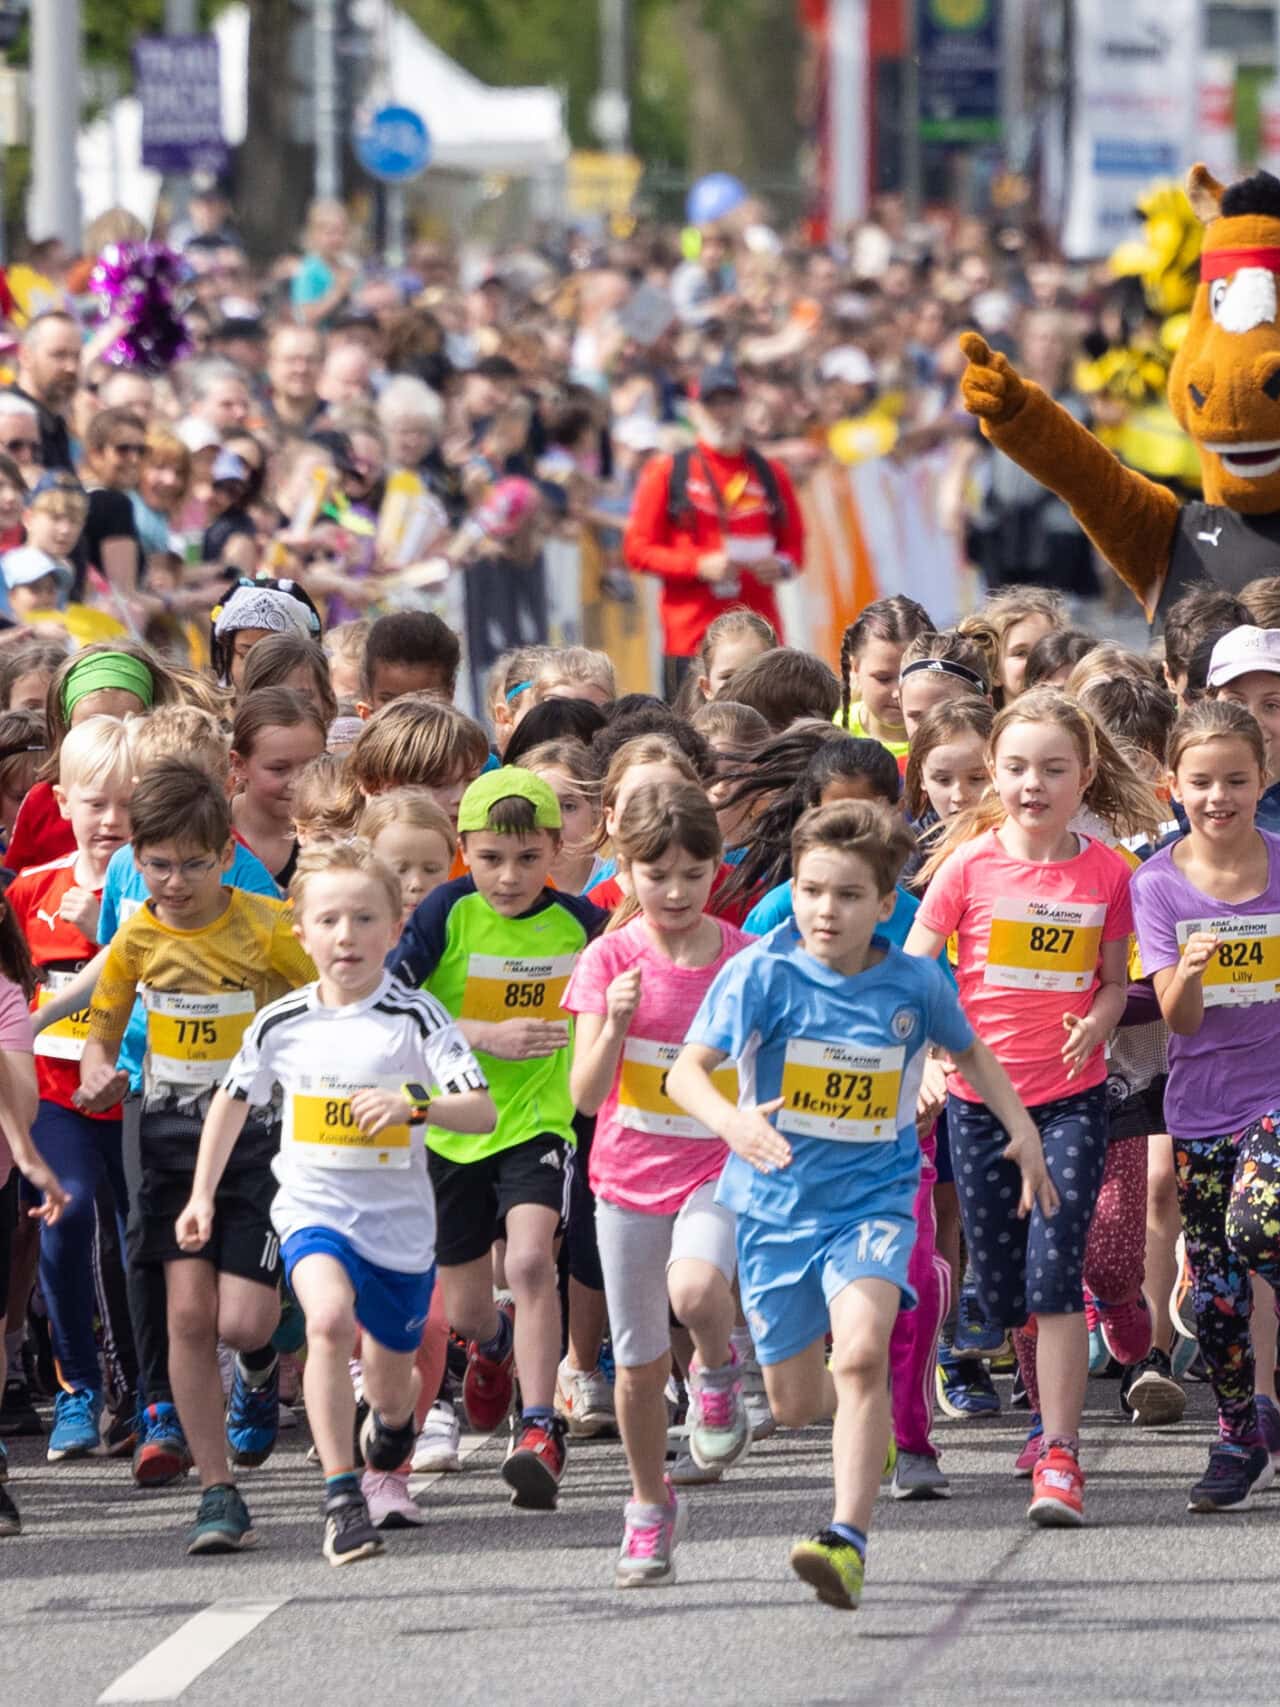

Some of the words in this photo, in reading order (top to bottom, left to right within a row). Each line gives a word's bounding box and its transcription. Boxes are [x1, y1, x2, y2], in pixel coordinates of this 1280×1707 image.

[1029, 926, 1075, 955] 827
[1219, 923, 1268, 933] MARATHON
[1218, 941, 1264, 968] 824
[1232, 970, 1253, 983] Lilly
[504, 982, 546, 1009] 858
[174, 1019, 218, 1045] 775
[831, 1054, 882, 1065] MARATHON
[824, 1071, 873, 1102] 873
[325, 1101, 356, 1127] 80
[791, 1090, 853, 1121] Henry
[856, 1220, 902, 1264] 17
